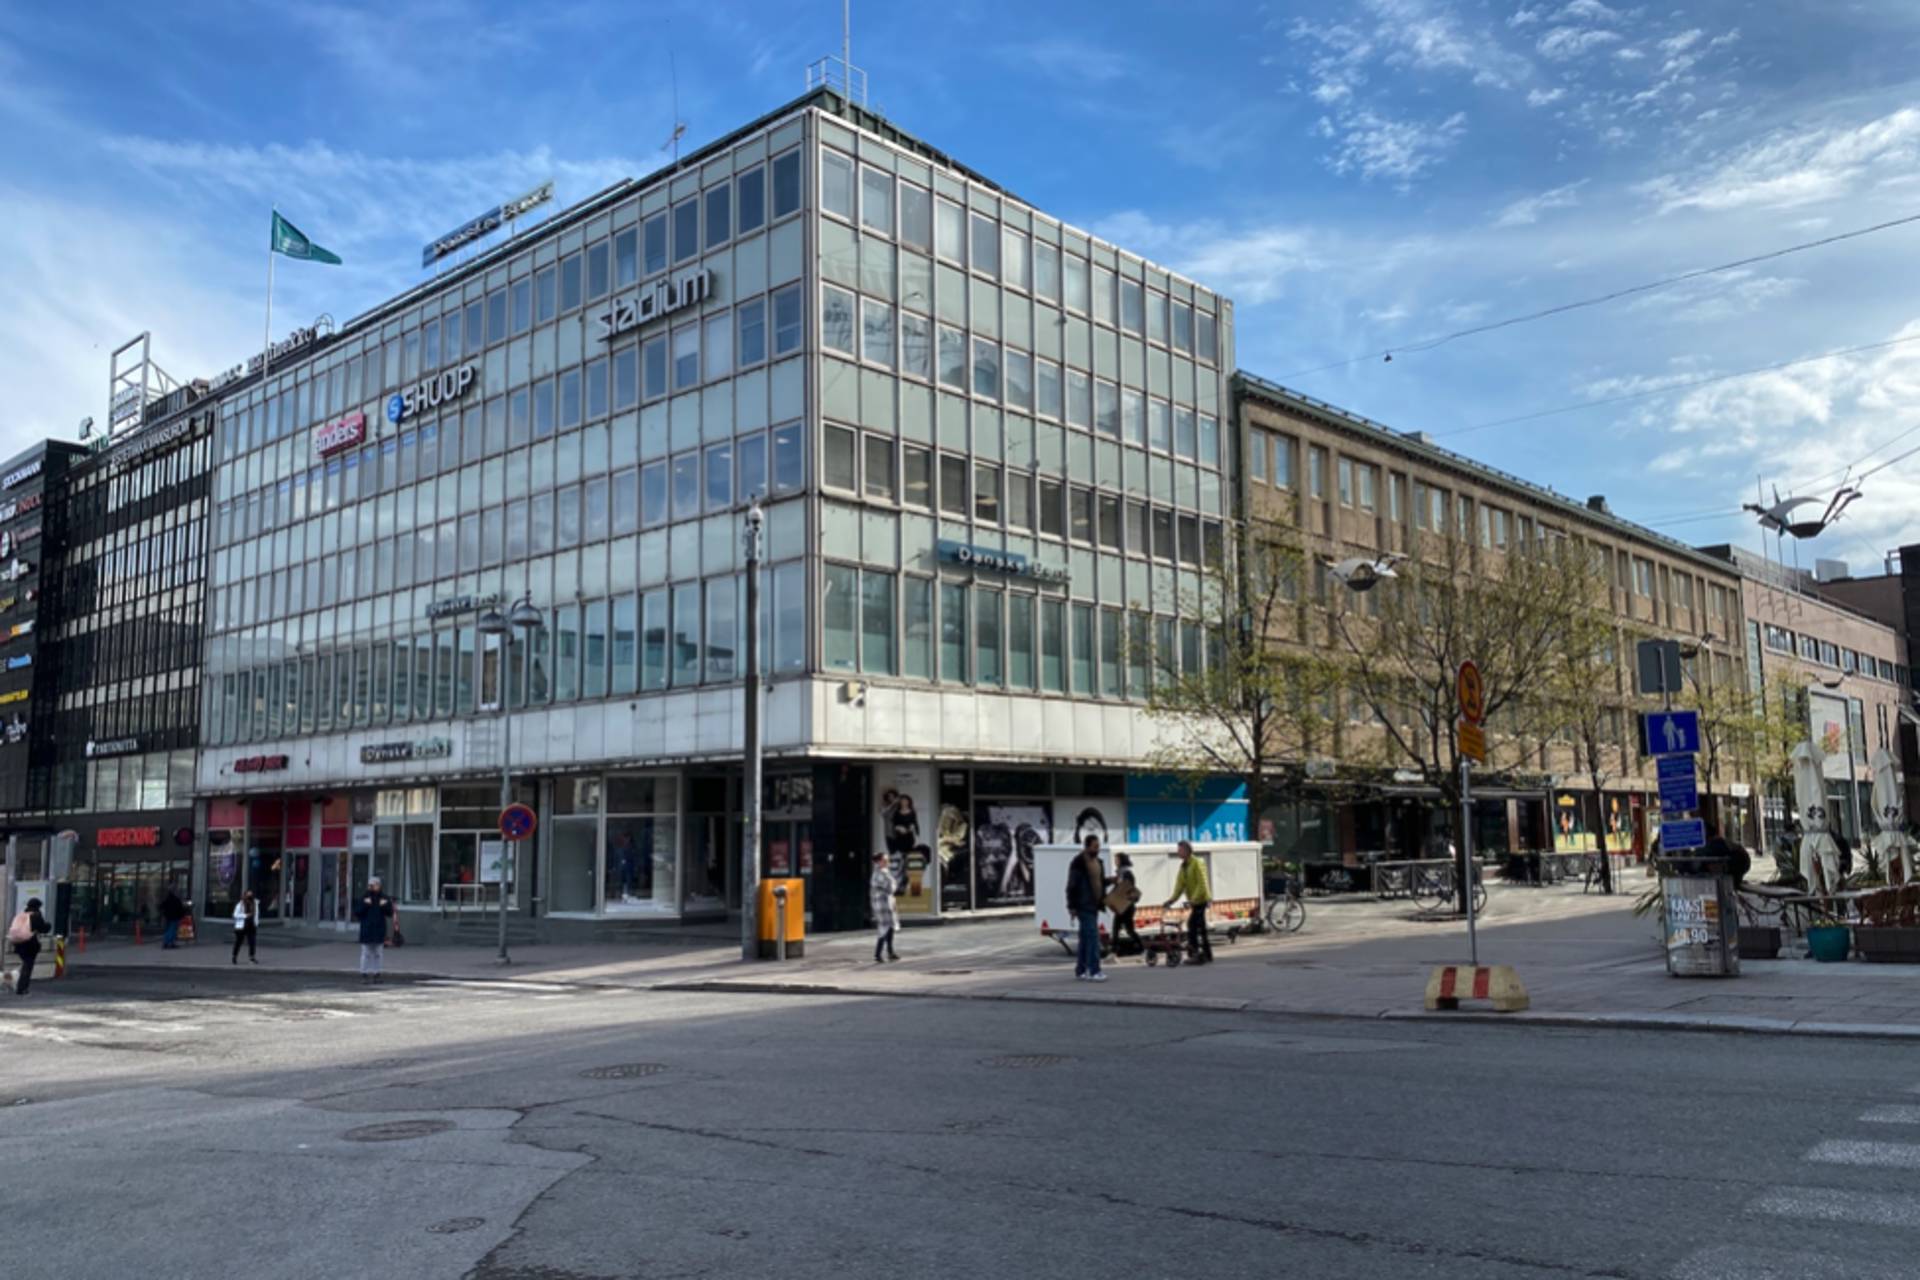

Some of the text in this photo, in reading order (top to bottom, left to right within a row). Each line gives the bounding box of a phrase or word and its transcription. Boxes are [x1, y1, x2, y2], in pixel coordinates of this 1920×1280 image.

[595, 269, 711, 338] stadium
[402, 365, 474, 418] SHUUP
[957, 545, 1025, 573] Danske
